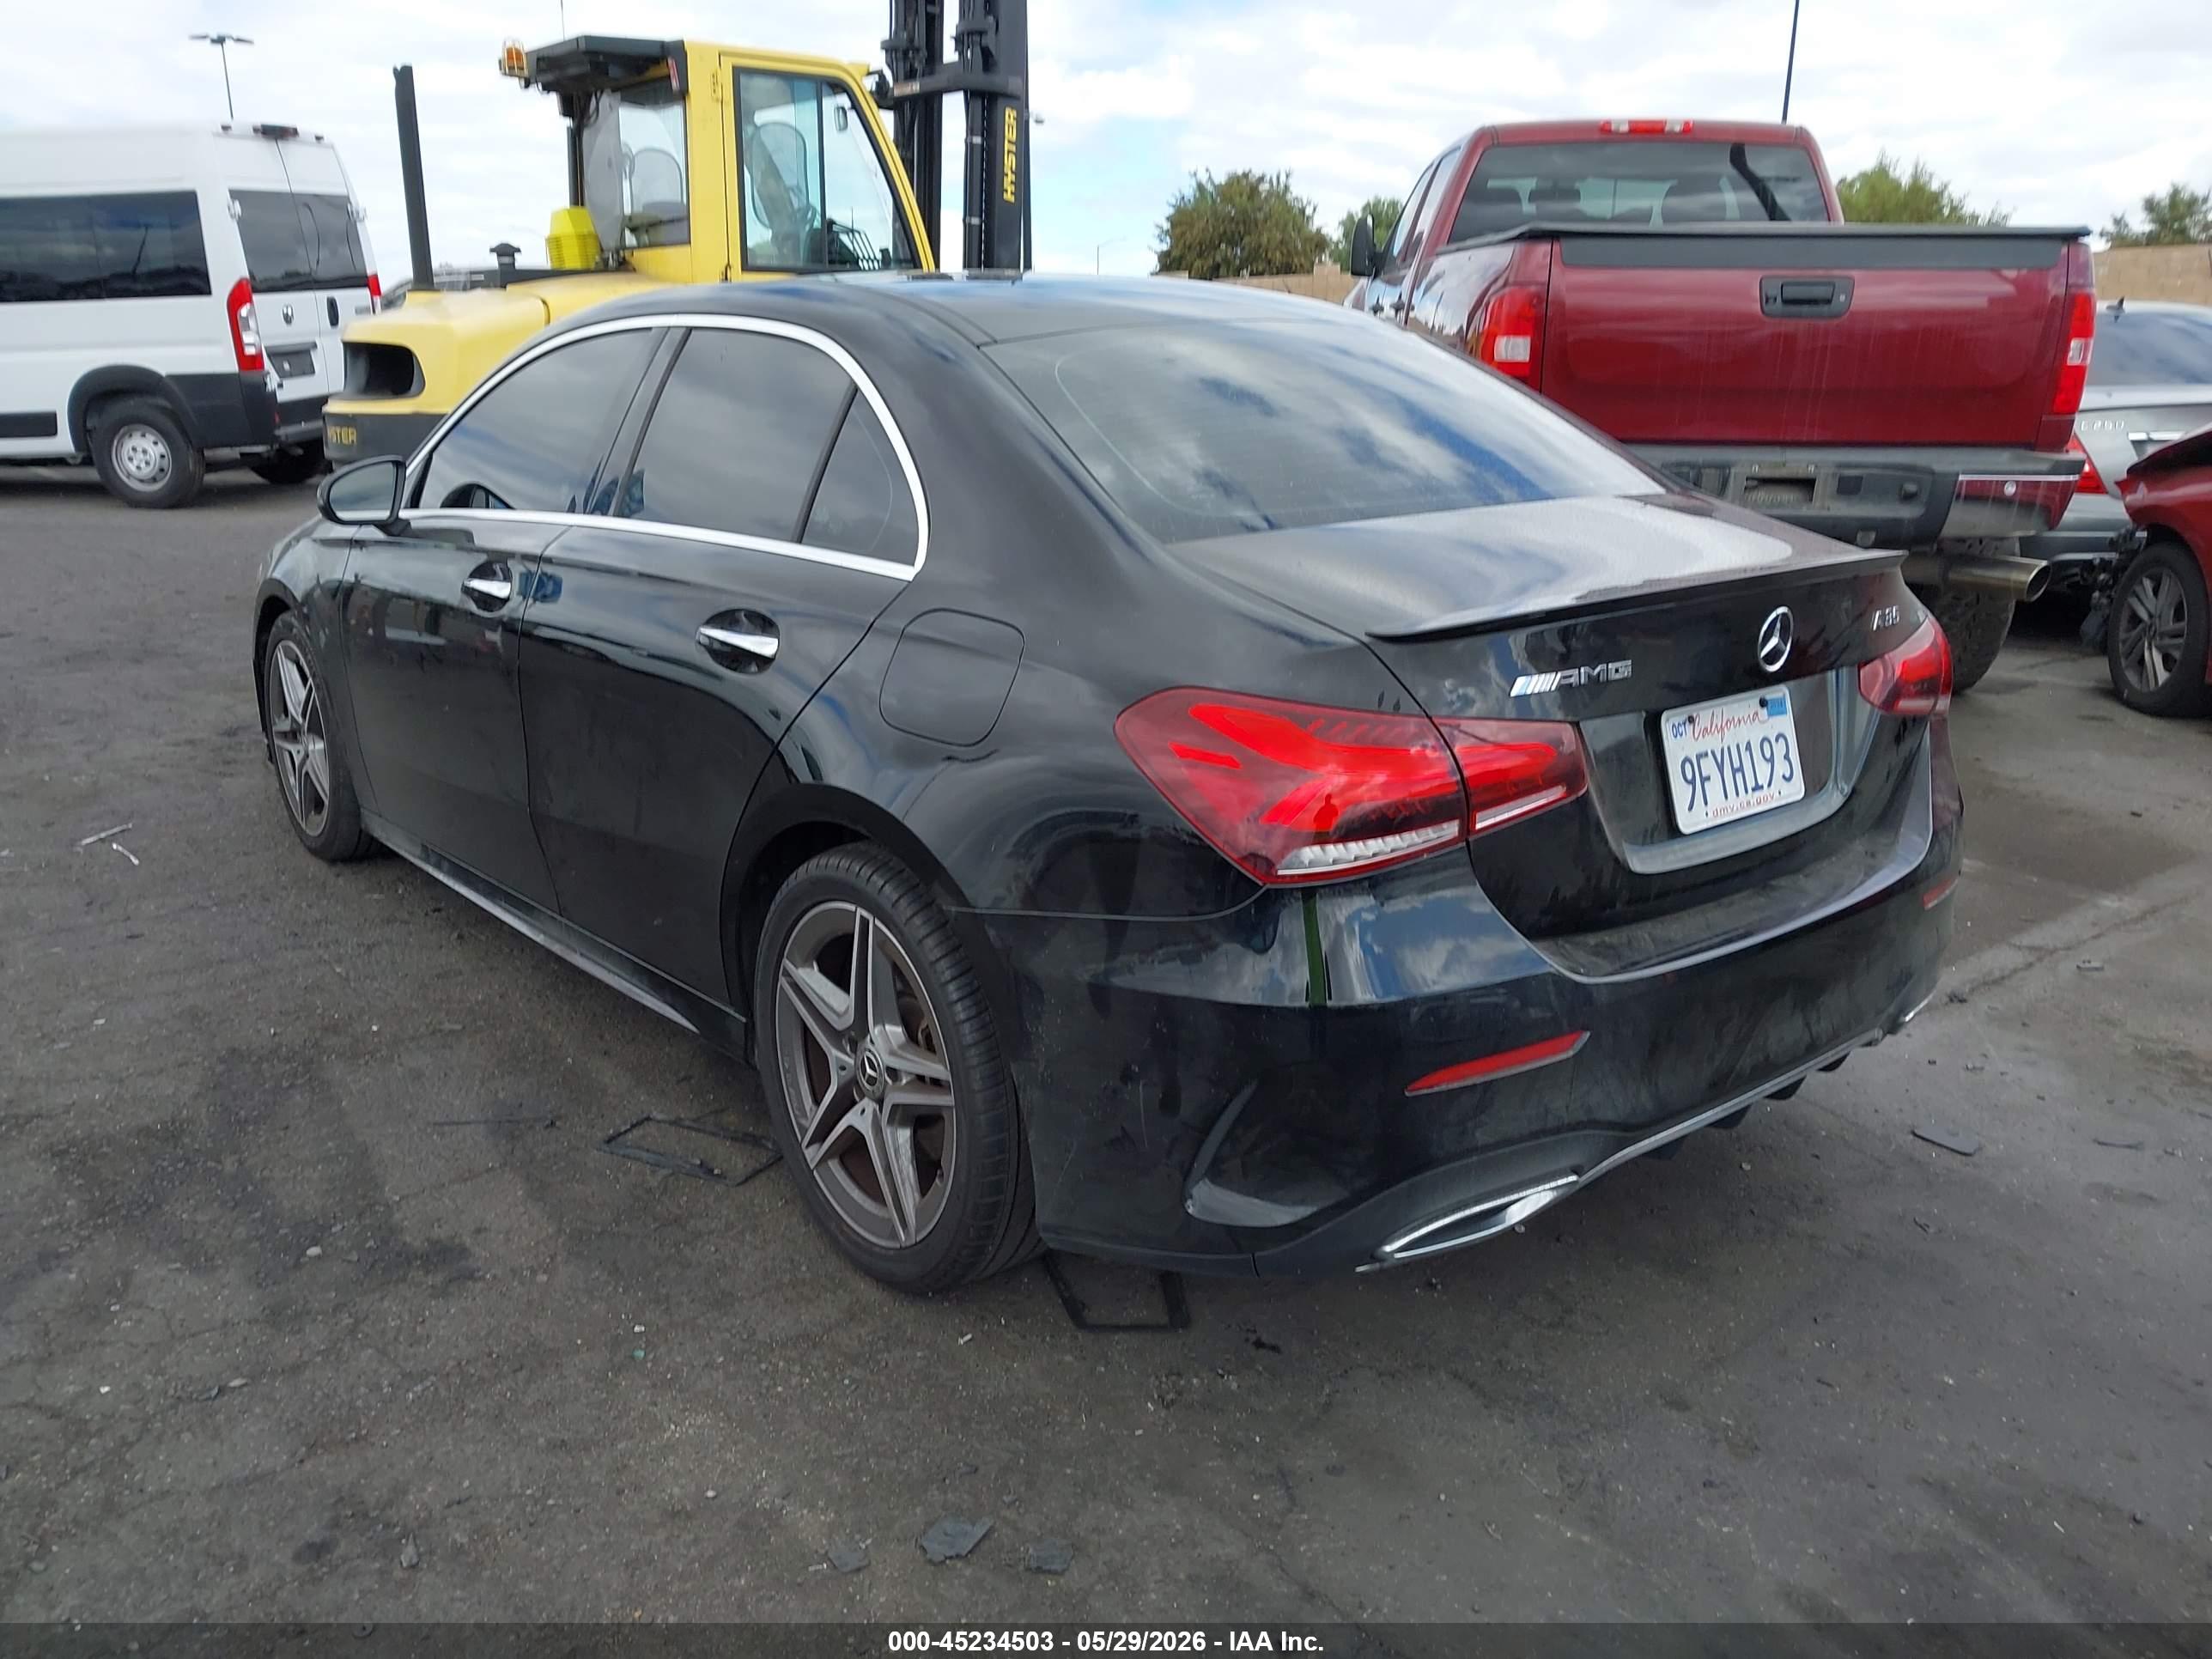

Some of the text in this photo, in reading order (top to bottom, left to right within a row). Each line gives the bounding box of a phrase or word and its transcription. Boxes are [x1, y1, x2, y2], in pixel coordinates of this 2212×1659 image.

[1003, 106, 1017, 204] HYSTER
[1550, 659, 1632, 692] AMG
[1671, 708, 1761, 742] OCT California
[1680, 732, 1794, 812] 9FYH193
[1712, 793, 1775, 817] dmv.ca.gov
